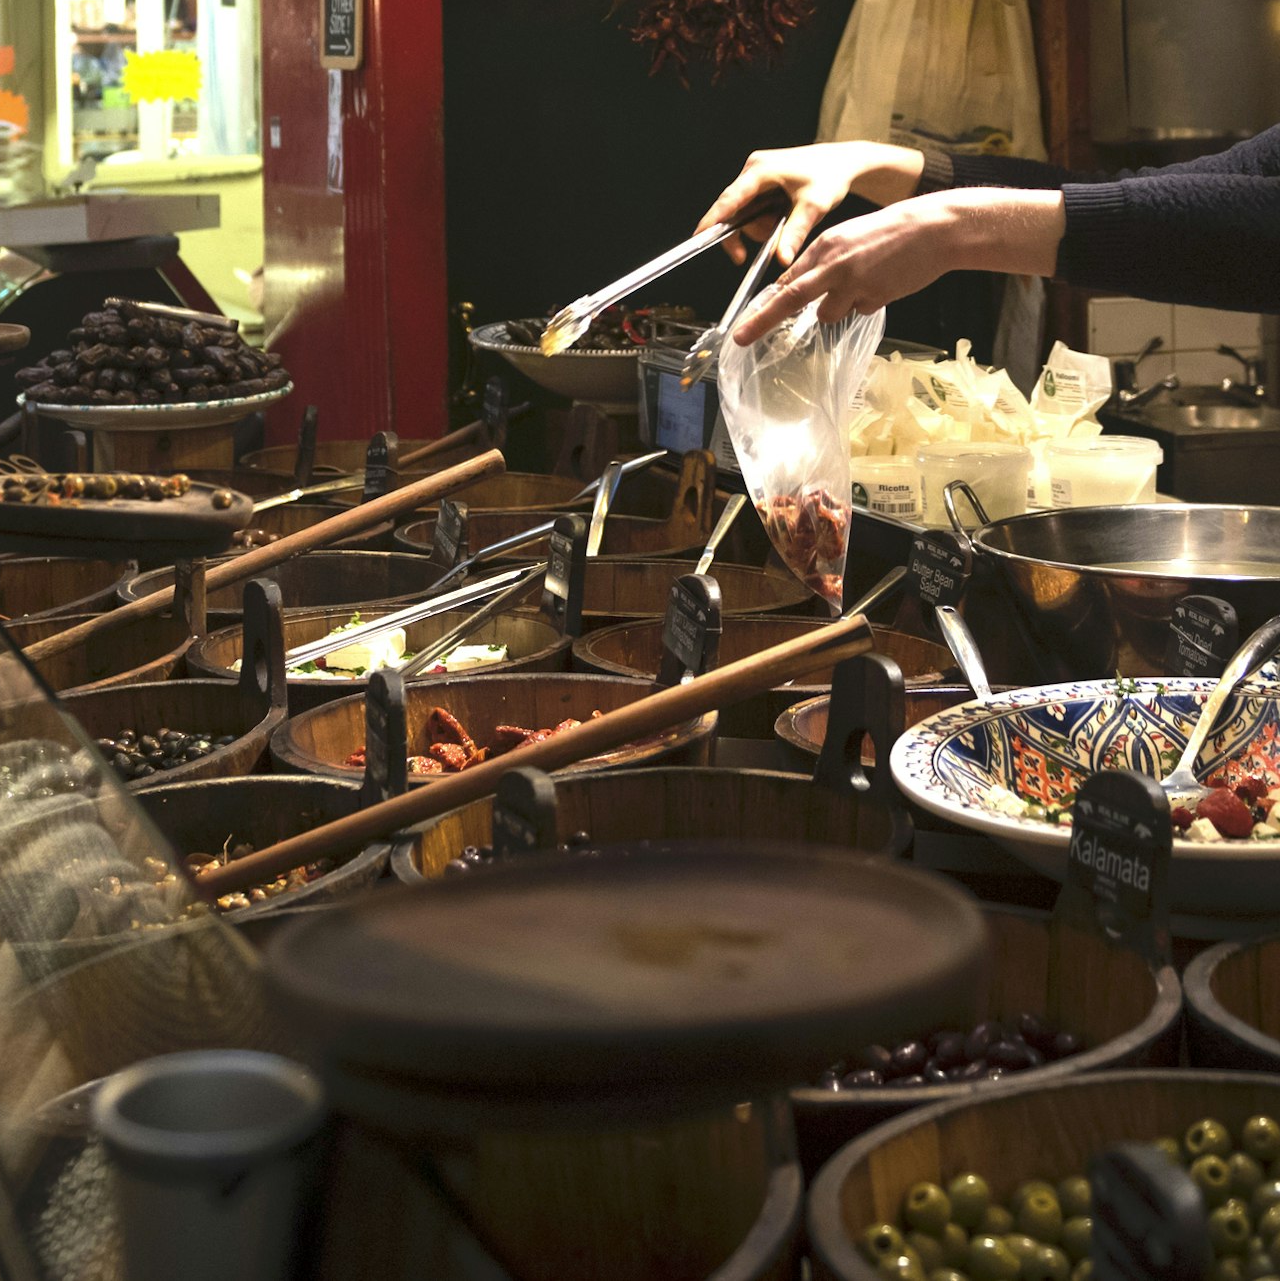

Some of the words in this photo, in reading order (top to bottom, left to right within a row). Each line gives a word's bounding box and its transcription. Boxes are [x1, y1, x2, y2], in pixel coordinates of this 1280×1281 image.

[878, 484, 910, 492] Ricotta
[920, 576, 940, 598] Salad
[934, 569, 954, 590] Bean
[1070, 828, 1151, 893] Kalamata
